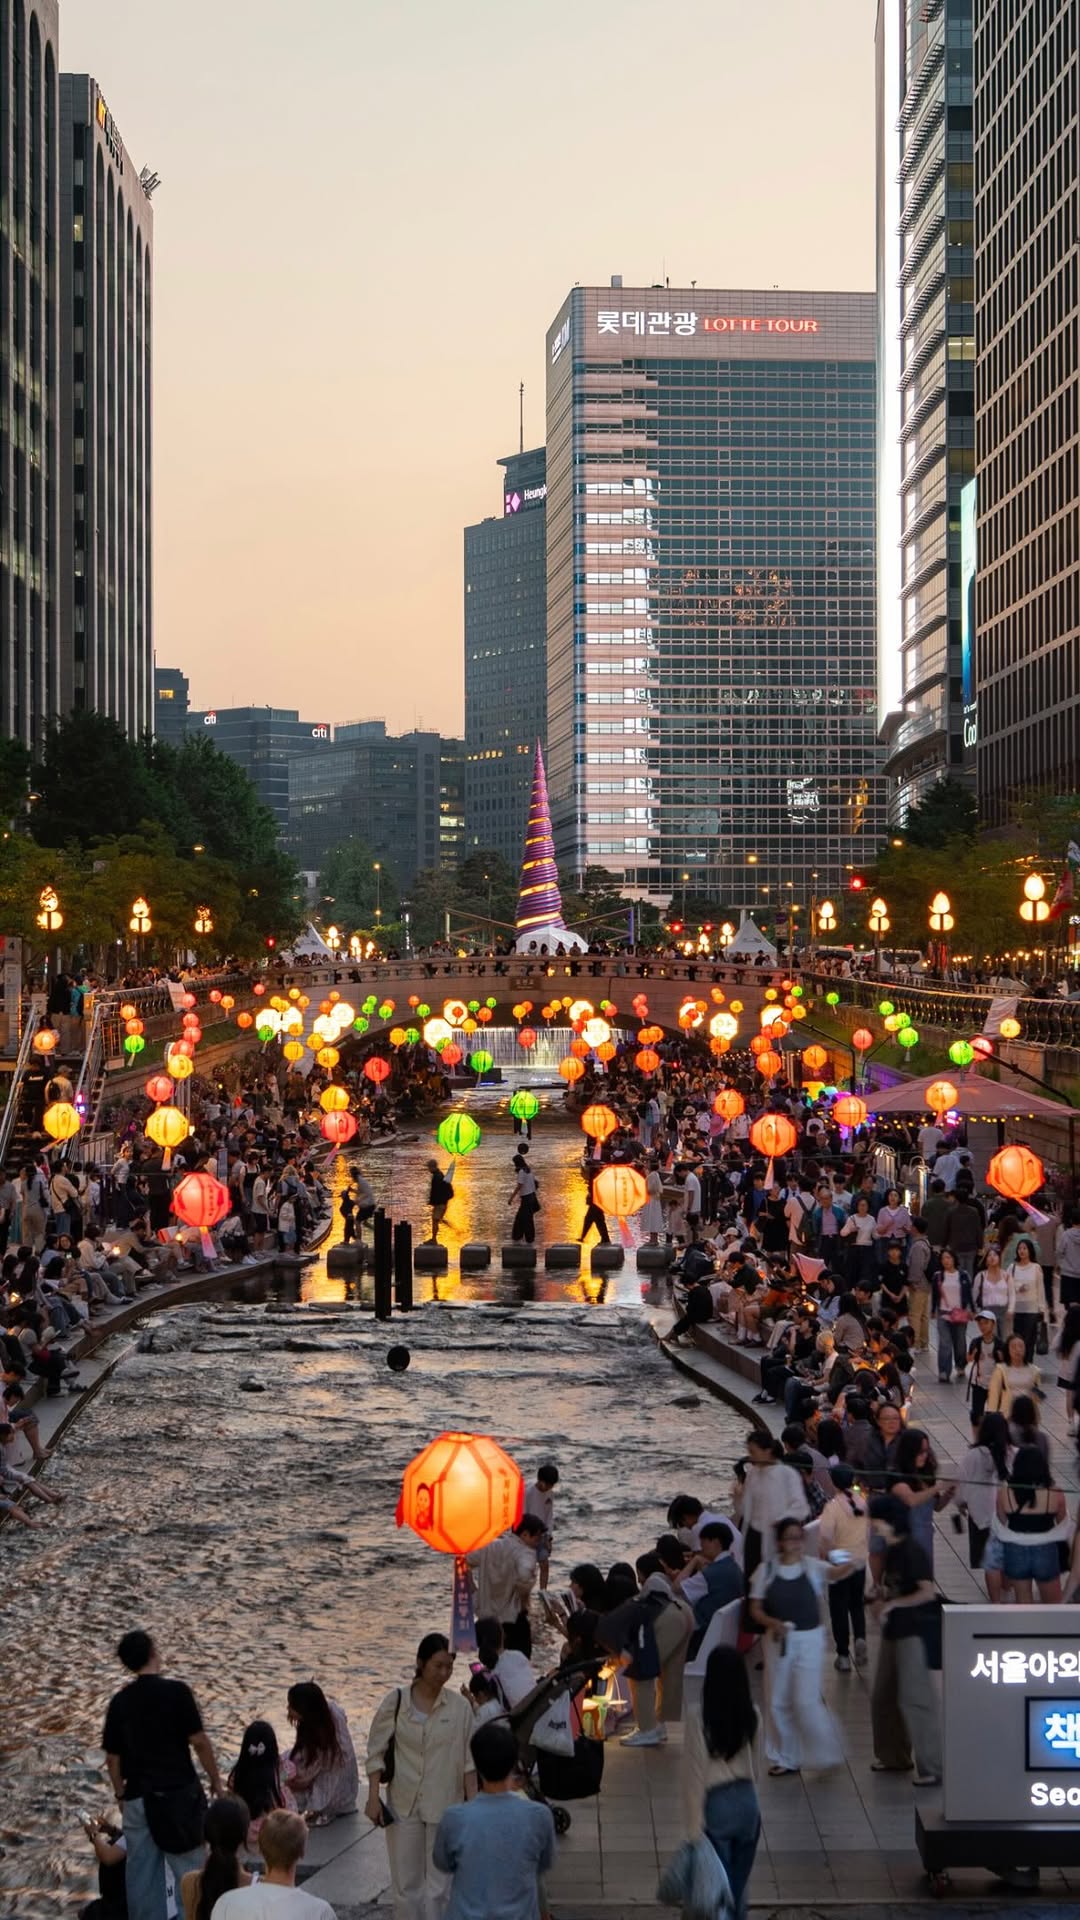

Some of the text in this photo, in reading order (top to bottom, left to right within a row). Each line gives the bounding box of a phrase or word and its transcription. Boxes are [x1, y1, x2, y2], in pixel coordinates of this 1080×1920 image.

[597, 311, 698, 336] 롯데관광
[704, 318, 818, 333] LOTTE TOUR
[204, 714, 217, 725] citi
[312, 726, 327, 739] citi
[1030, 1782, 1080, 1807] Seo
